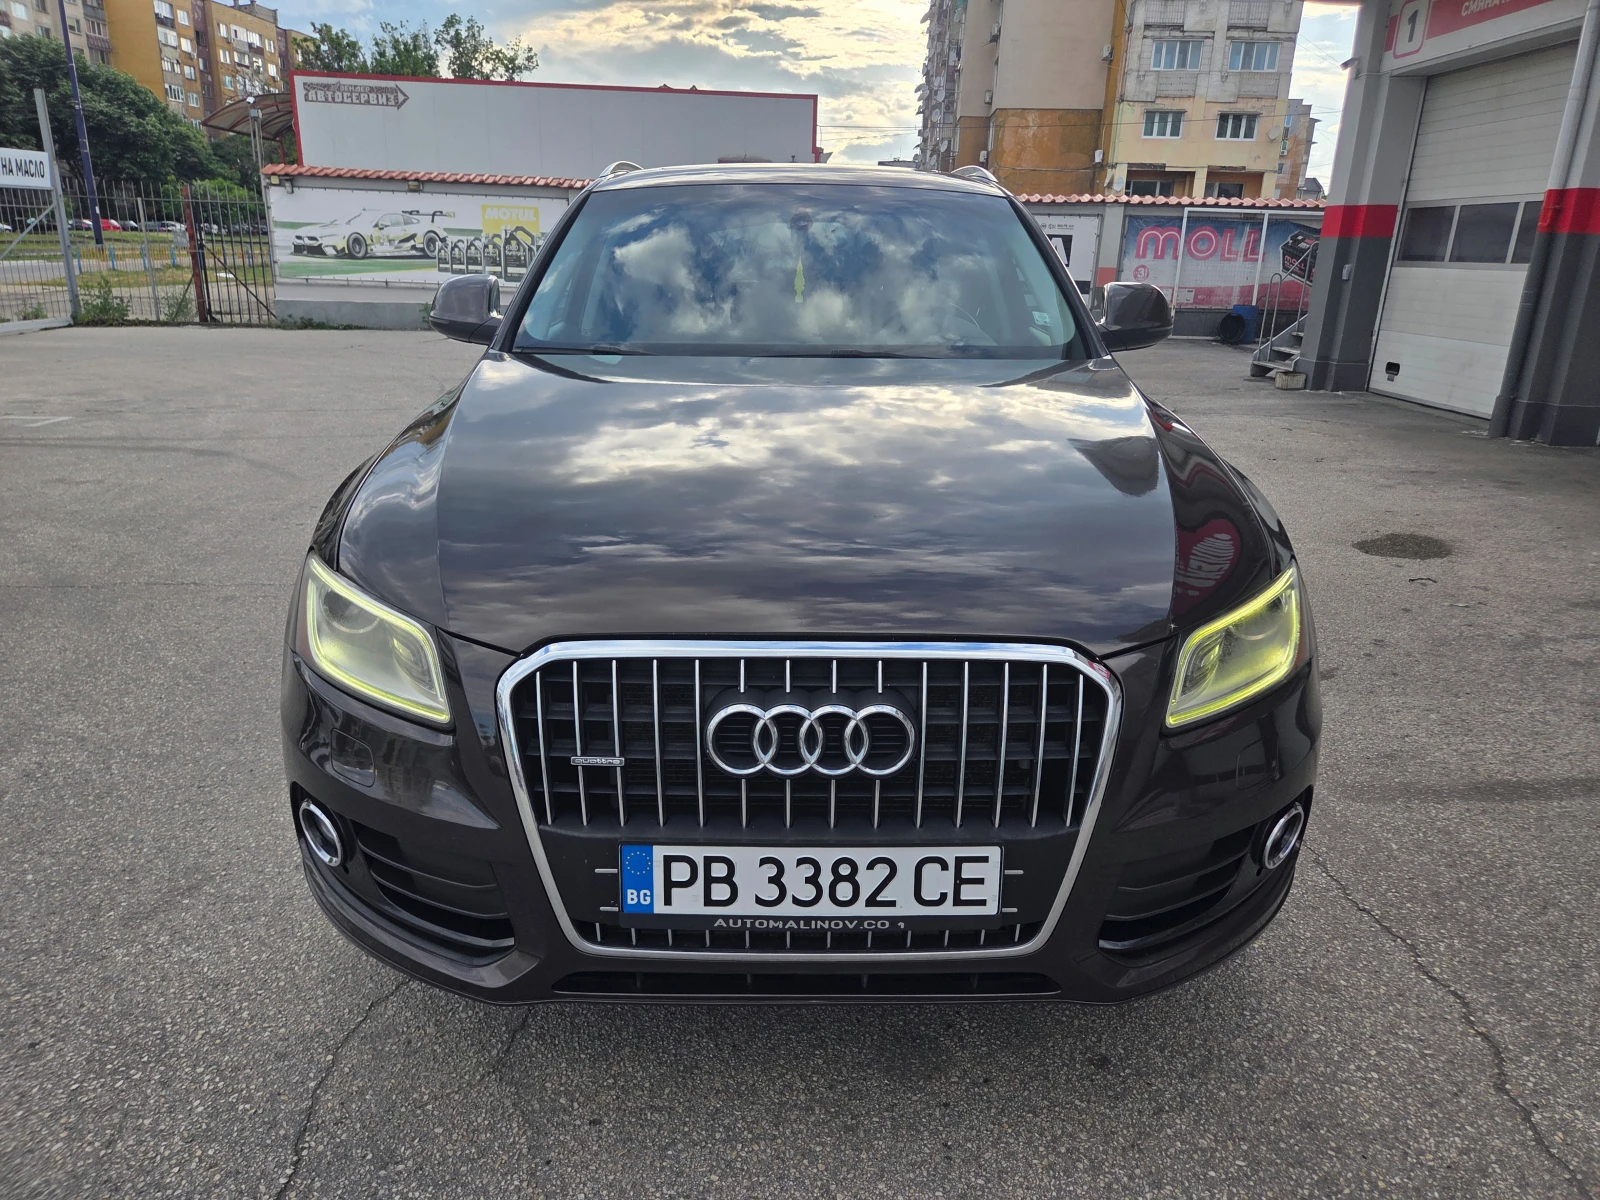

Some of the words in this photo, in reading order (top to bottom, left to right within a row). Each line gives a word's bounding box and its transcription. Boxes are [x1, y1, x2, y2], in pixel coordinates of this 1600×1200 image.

[1407, 10, 1419, 43] 1
[308, 90, 395, 105] АВТОСЕРВИЗ
[1, 157, 14, 176] НА
[15, 157, 45, 178] МАСЛО
[485, 207, 536, 221] MOTUL
[1135, 226, 1266, 263] MOLL
[662, 855, 739, 906] PB
[754, 855, 898, 908] 3382
[913, 855, 990, 906] CE
[627, 888, 651, 905] BG
